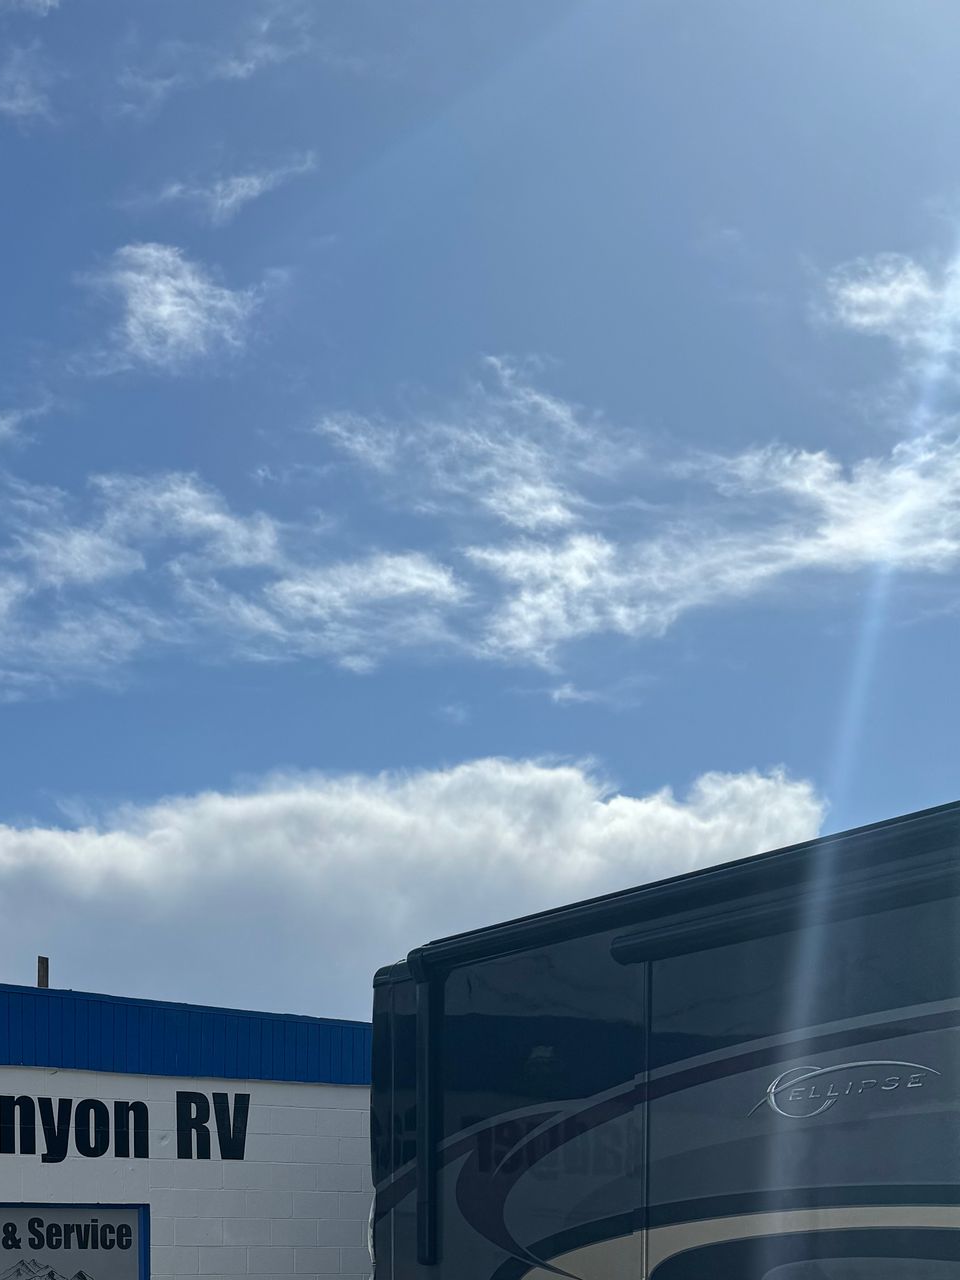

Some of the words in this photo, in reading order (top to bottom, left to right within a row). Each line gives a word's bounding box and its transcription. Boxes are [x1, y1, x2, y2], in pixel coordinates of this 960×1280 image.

[789, 1073, 927, 1101] ELLIPSE
[176, 1090, 251, 1160] RV
[2, 1222, 22, 1250] &
[28, 1217, 132, 1250] Service
